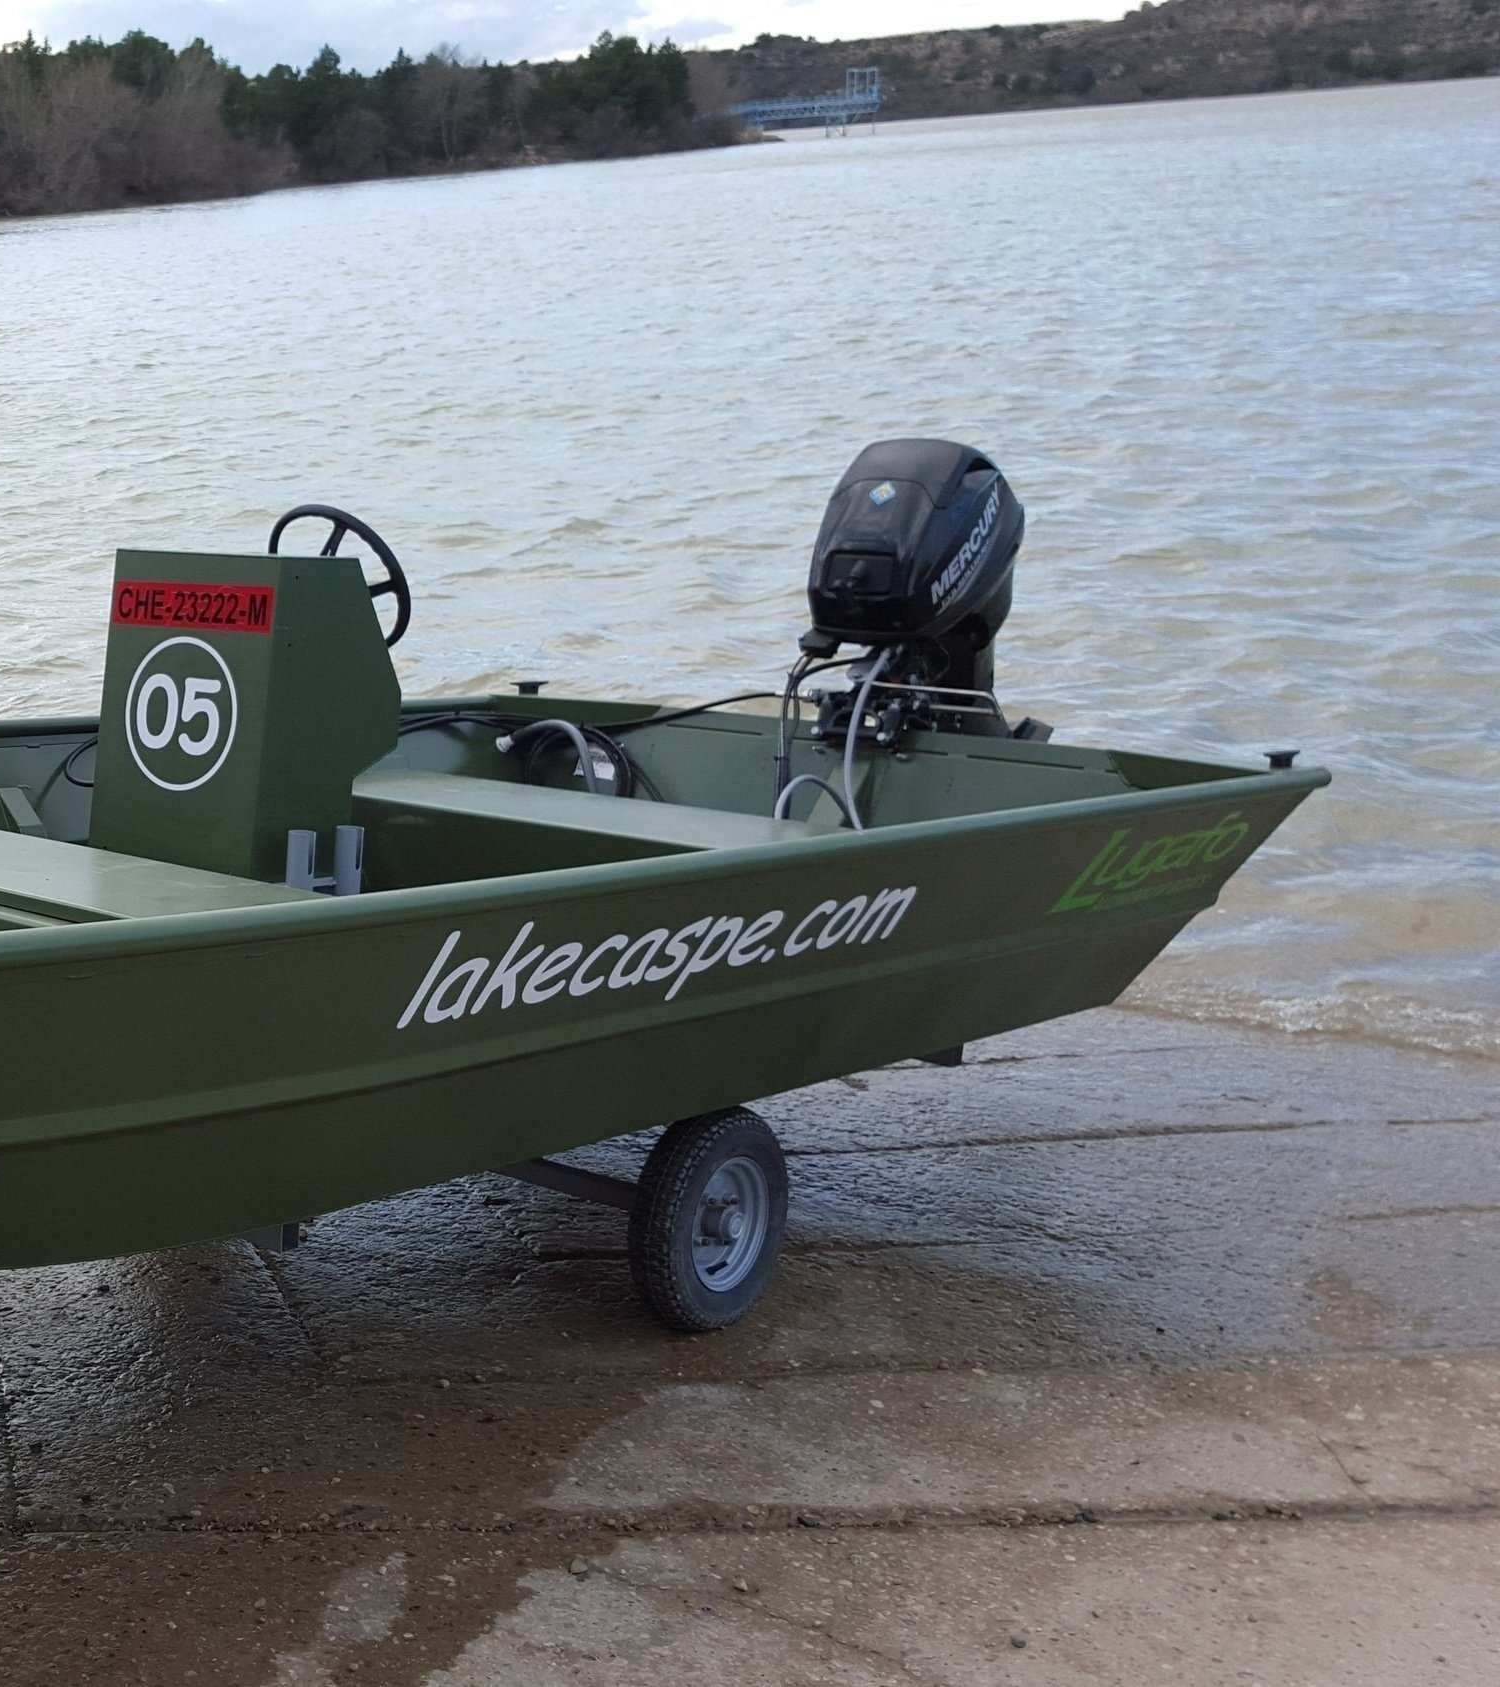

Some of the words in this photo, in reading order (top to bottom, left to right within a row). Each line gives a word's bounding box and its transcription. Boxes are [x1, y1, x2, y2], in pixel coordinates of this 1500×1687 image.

[931, 480, 1000, 605] MERCURY
[118, 587, 268, 627] CHE-23222-M
[136, 673, 222, 757] 05
[396, 885, 918, 1030] lakecaspe.com
